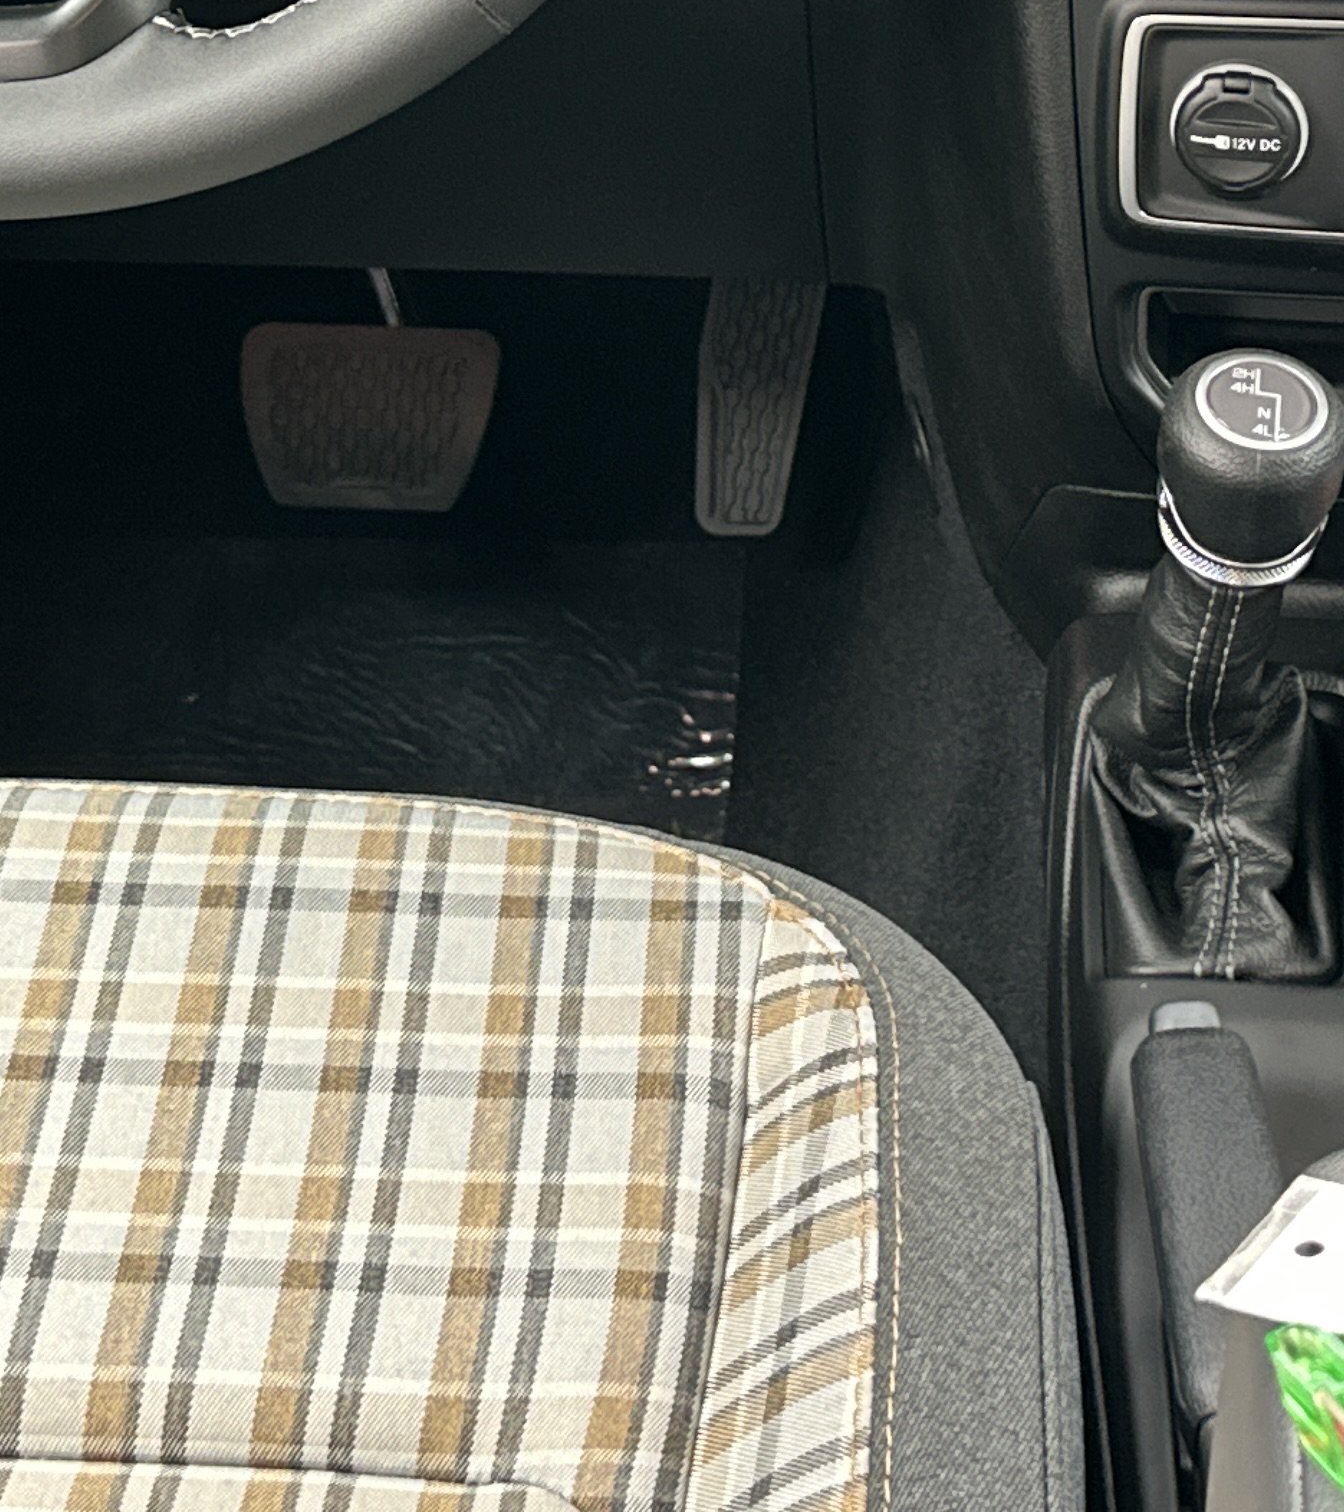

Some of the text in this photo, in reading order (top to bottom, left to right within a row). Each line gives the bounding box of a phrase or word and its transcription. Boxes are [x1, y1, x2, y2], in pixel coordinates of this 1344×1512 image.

[1231, 137, 1282, 152] 12V DC
[1231, 367, 1255, 380] 2H
[1230, 381, 1255, 395] 4H
[1257, 406, 1272, 419] N
[1251, 423, 1273, 437] 4L
